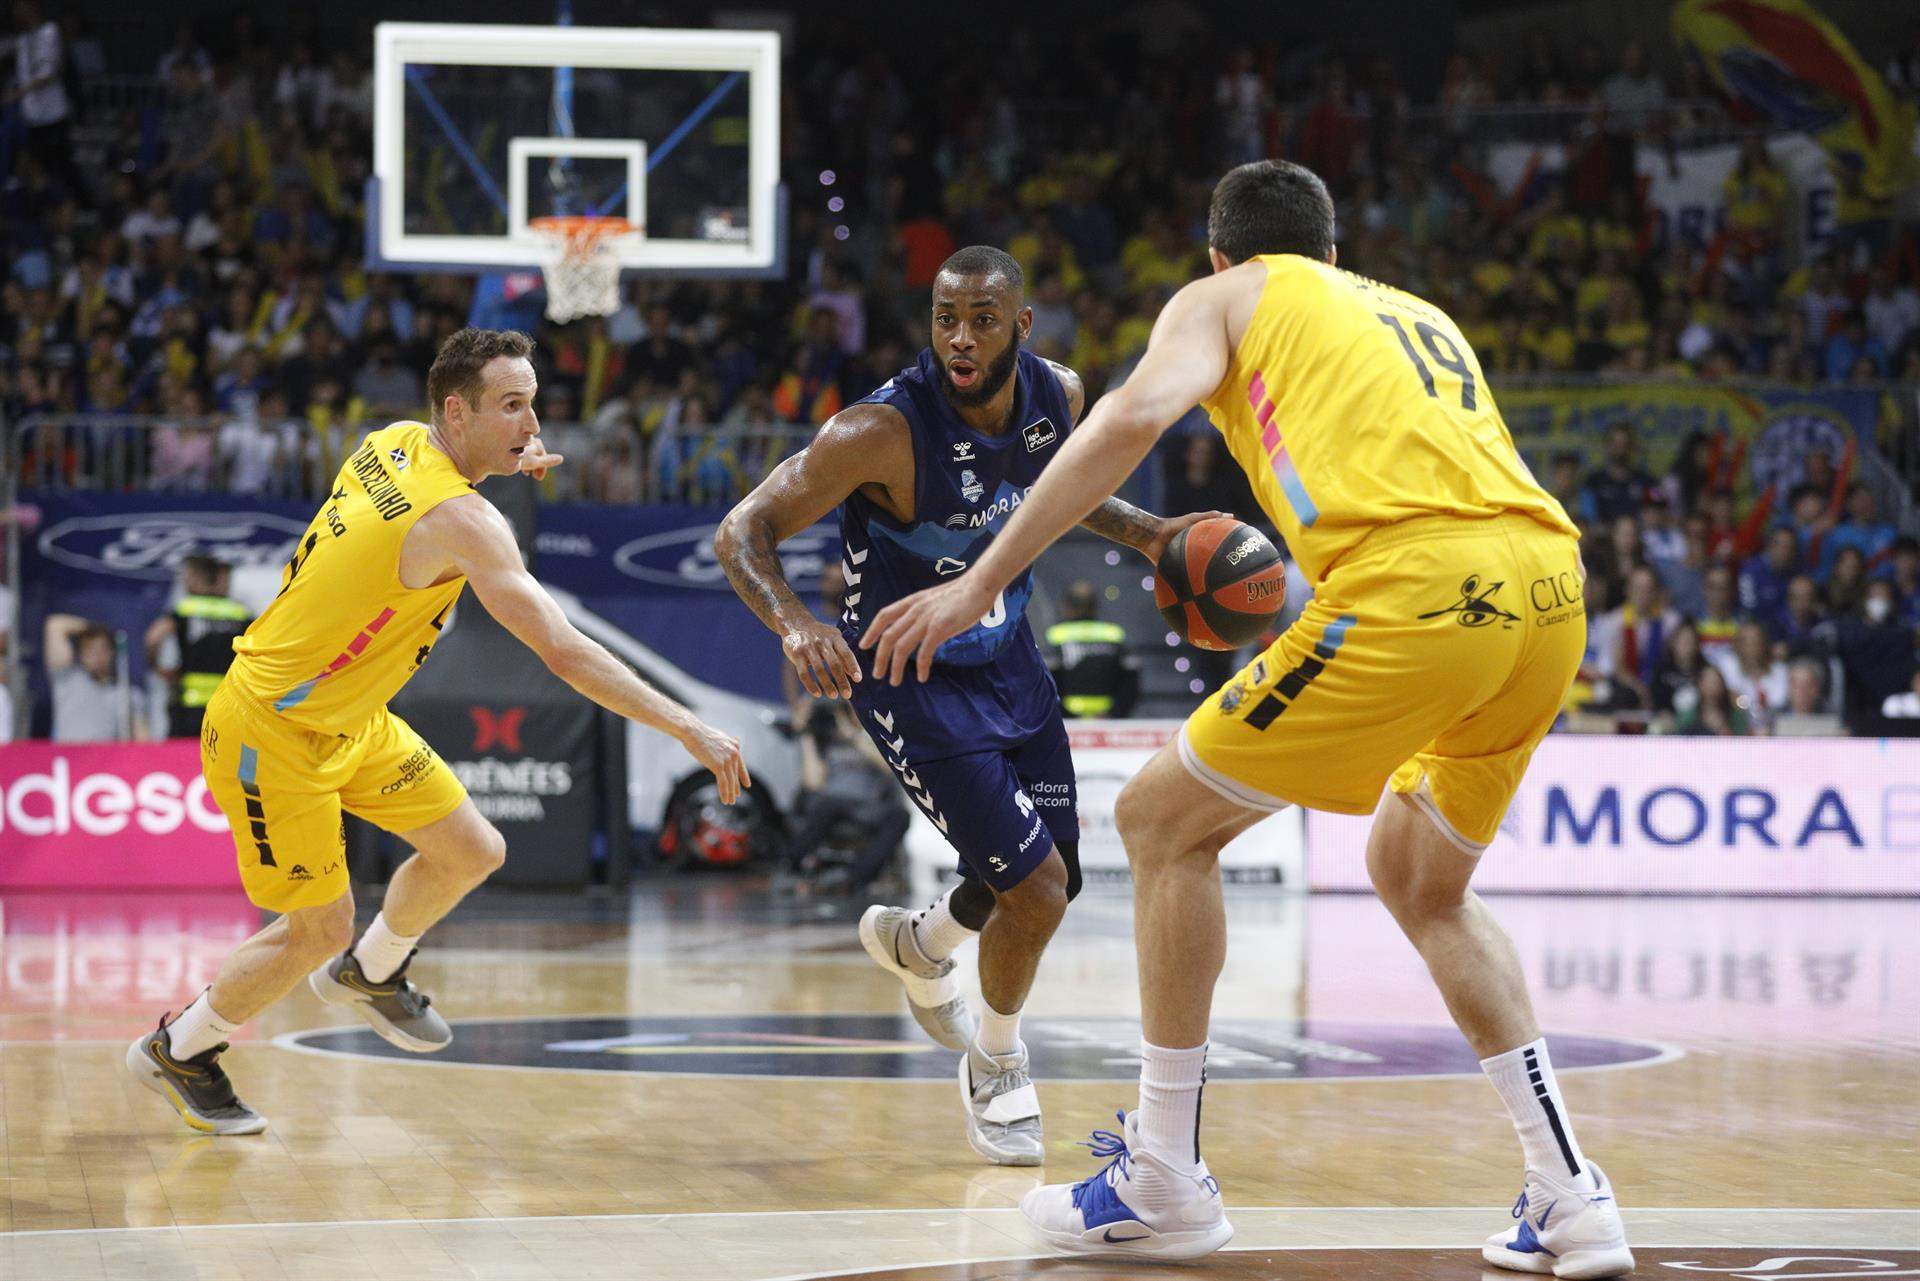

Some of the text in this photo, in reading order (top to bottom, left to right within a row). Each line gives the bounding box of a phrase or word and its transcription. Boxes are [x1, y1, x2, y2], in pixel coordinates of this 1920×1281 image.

[1376, 313, 1477, 412] 19
[381, 757, 430, 795] Canarias
[399, 750, 424, 773] Islas
[1031, 781, 1069, 794] dorra
[1031, 794, 1070, 807] lecom
[1018, 815, 1043, 853] Andorr
